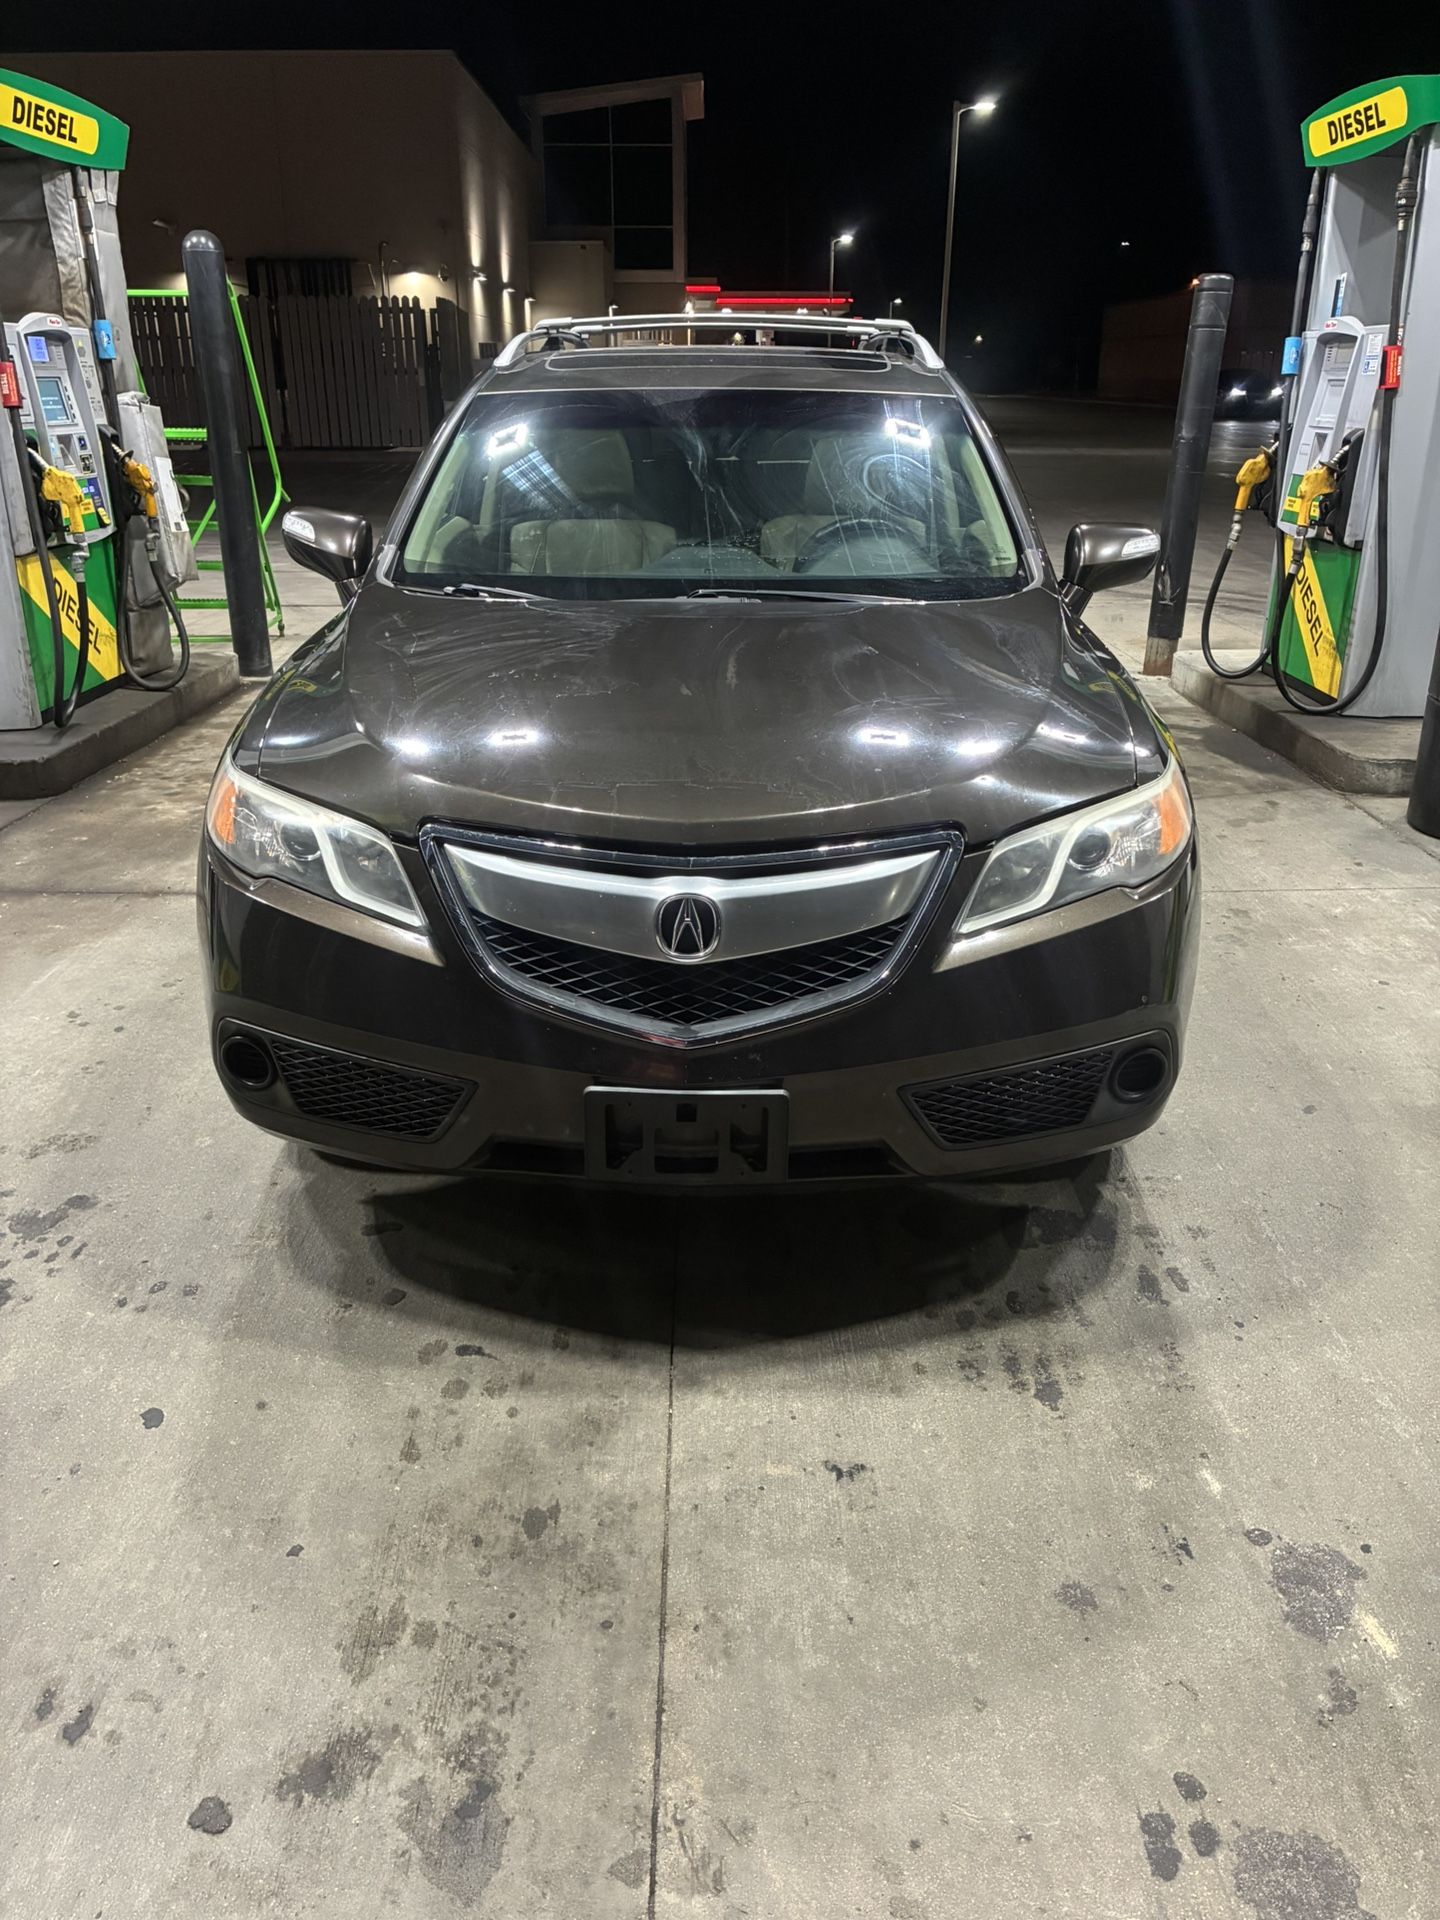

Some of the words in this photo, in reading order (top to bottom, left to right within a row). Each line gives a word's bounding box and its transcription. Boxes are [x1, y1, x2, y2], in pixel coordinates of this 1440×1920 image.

[12, 96, 78, 145] DIESEL
[1327, 102, 1386, 146] DIESEL
[1295, 563, 1324, 657] DIESEL
